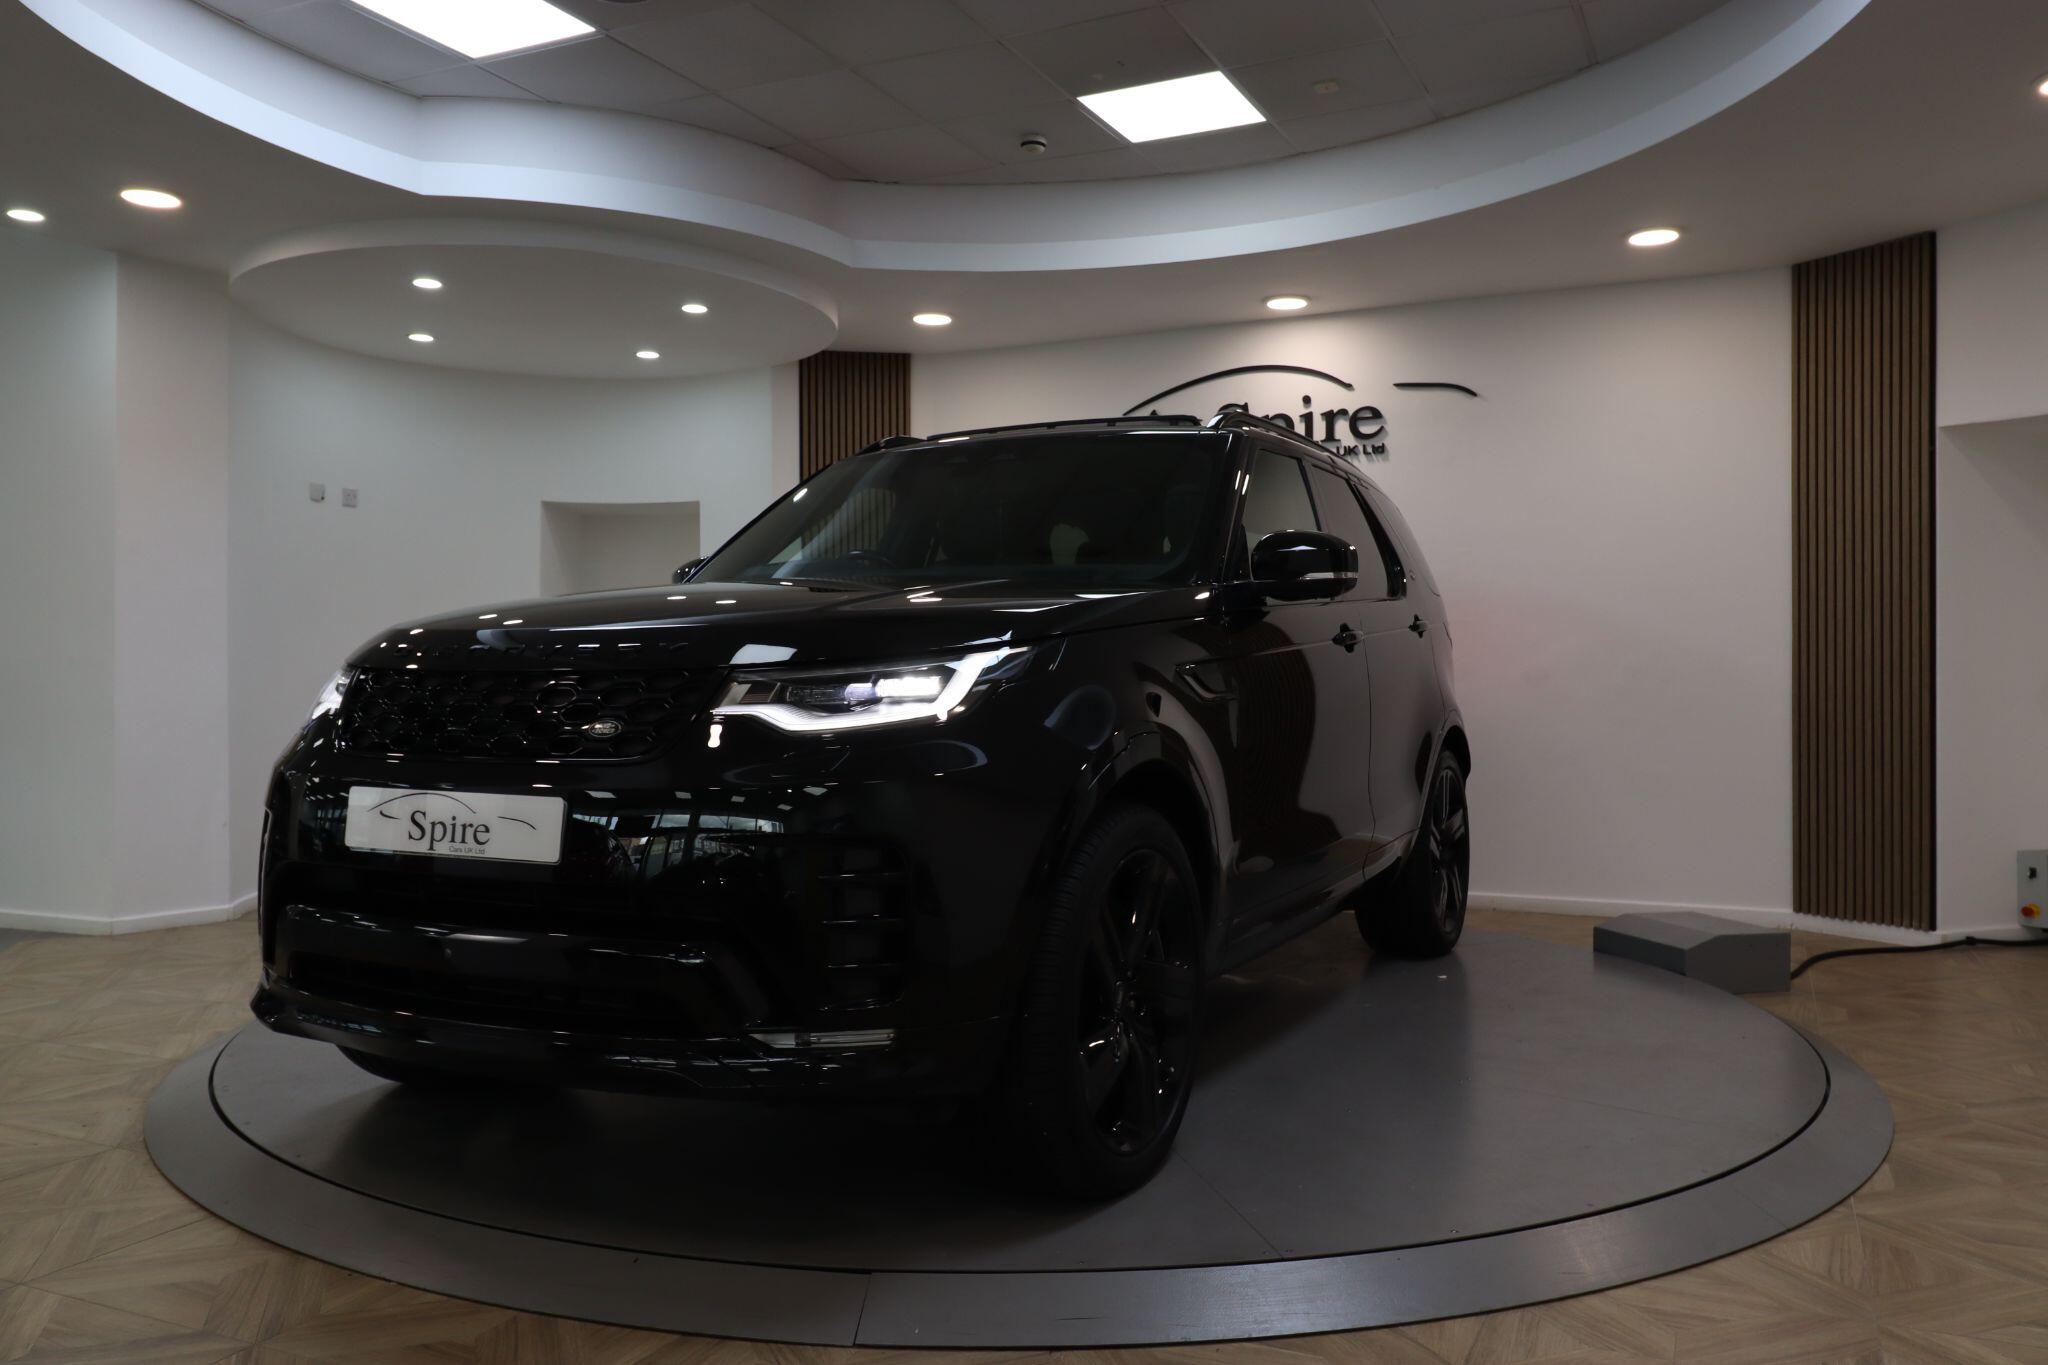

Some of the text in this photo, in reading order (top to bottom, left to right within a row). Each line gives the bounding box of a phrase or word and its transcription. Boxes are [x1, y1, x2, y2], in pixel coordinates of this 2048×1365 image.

[1336, 442, 1385, 456] UK Ltd
[408, 810, 490, 851] Spire
